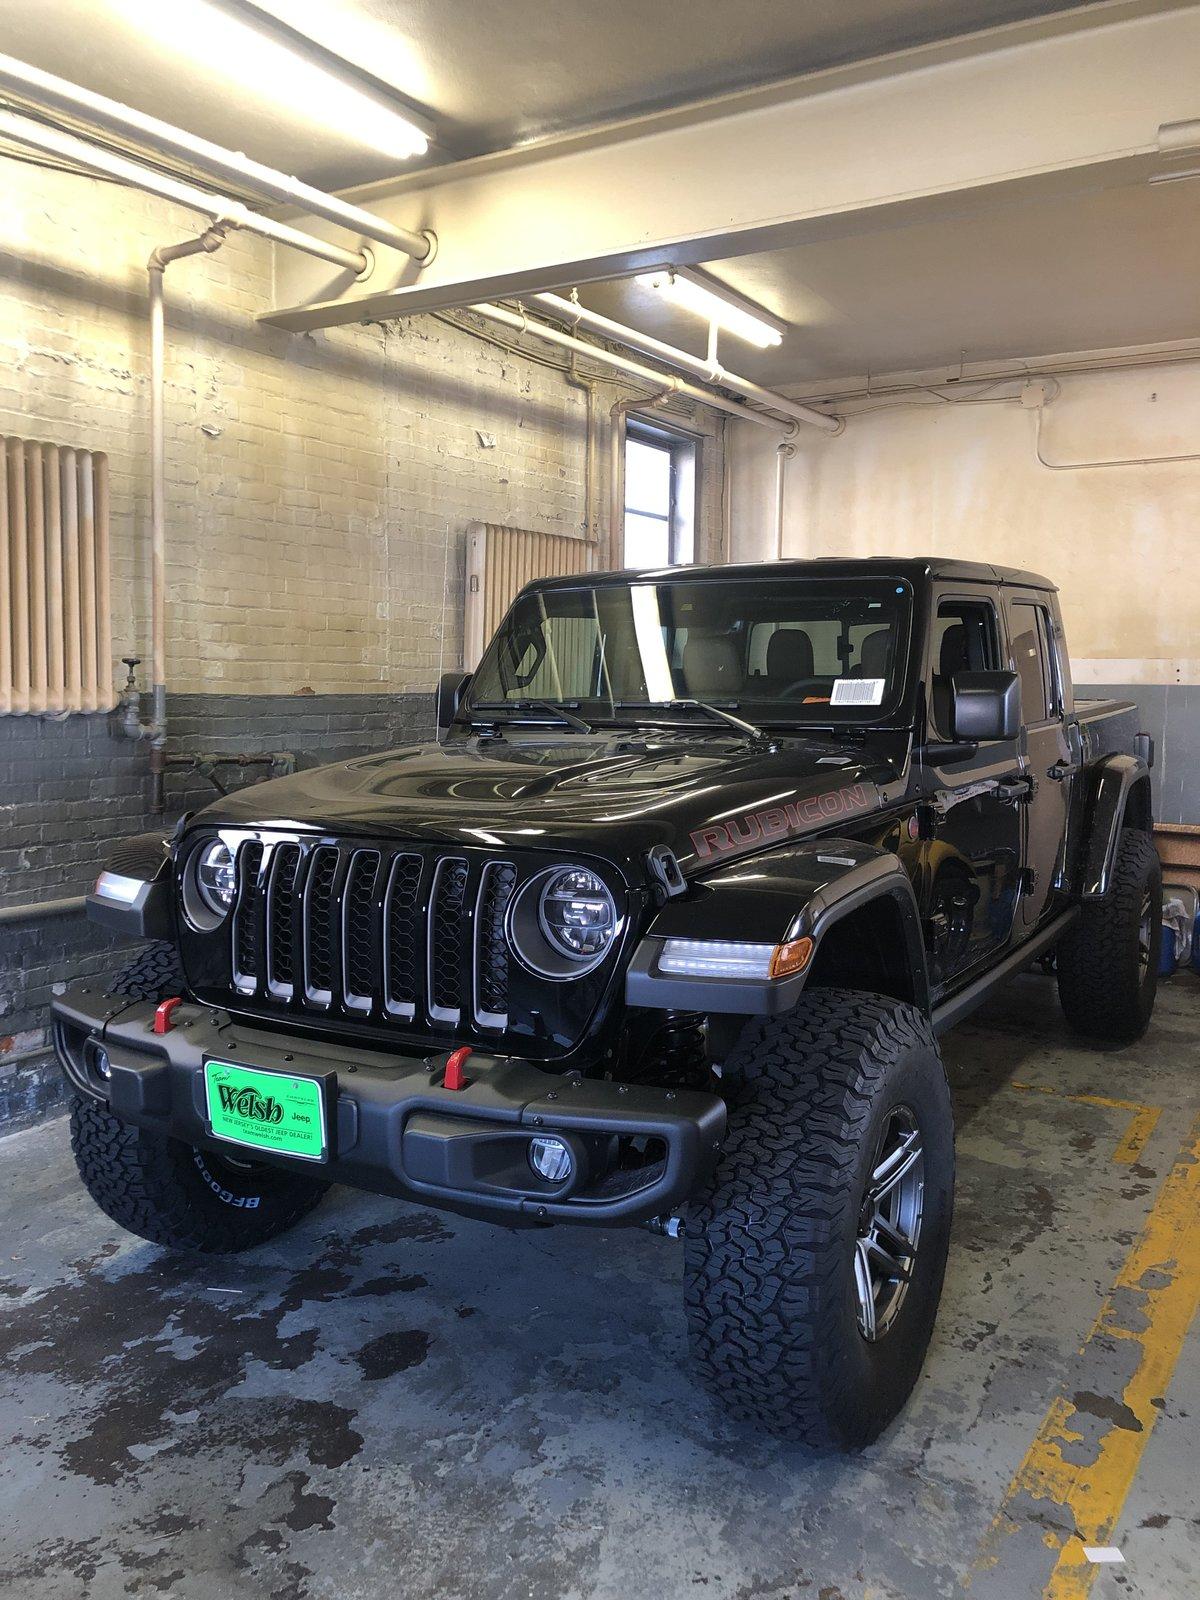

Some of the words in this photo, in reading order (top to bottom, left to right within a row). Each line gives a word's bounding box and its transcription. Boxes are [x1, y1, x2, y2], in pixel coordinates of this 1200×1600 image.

[689, 784, 868, 858] RUBICON
[217, 1083, 284, 1124] Welsh
[292, 1112, 311, 1124] Jeep
[234, 1119, 254, 1129] JERSEY'S
[255, 1124, 274, 1133] OLDEST
[242, 1129, 282, 1141] teamwelsh.com
